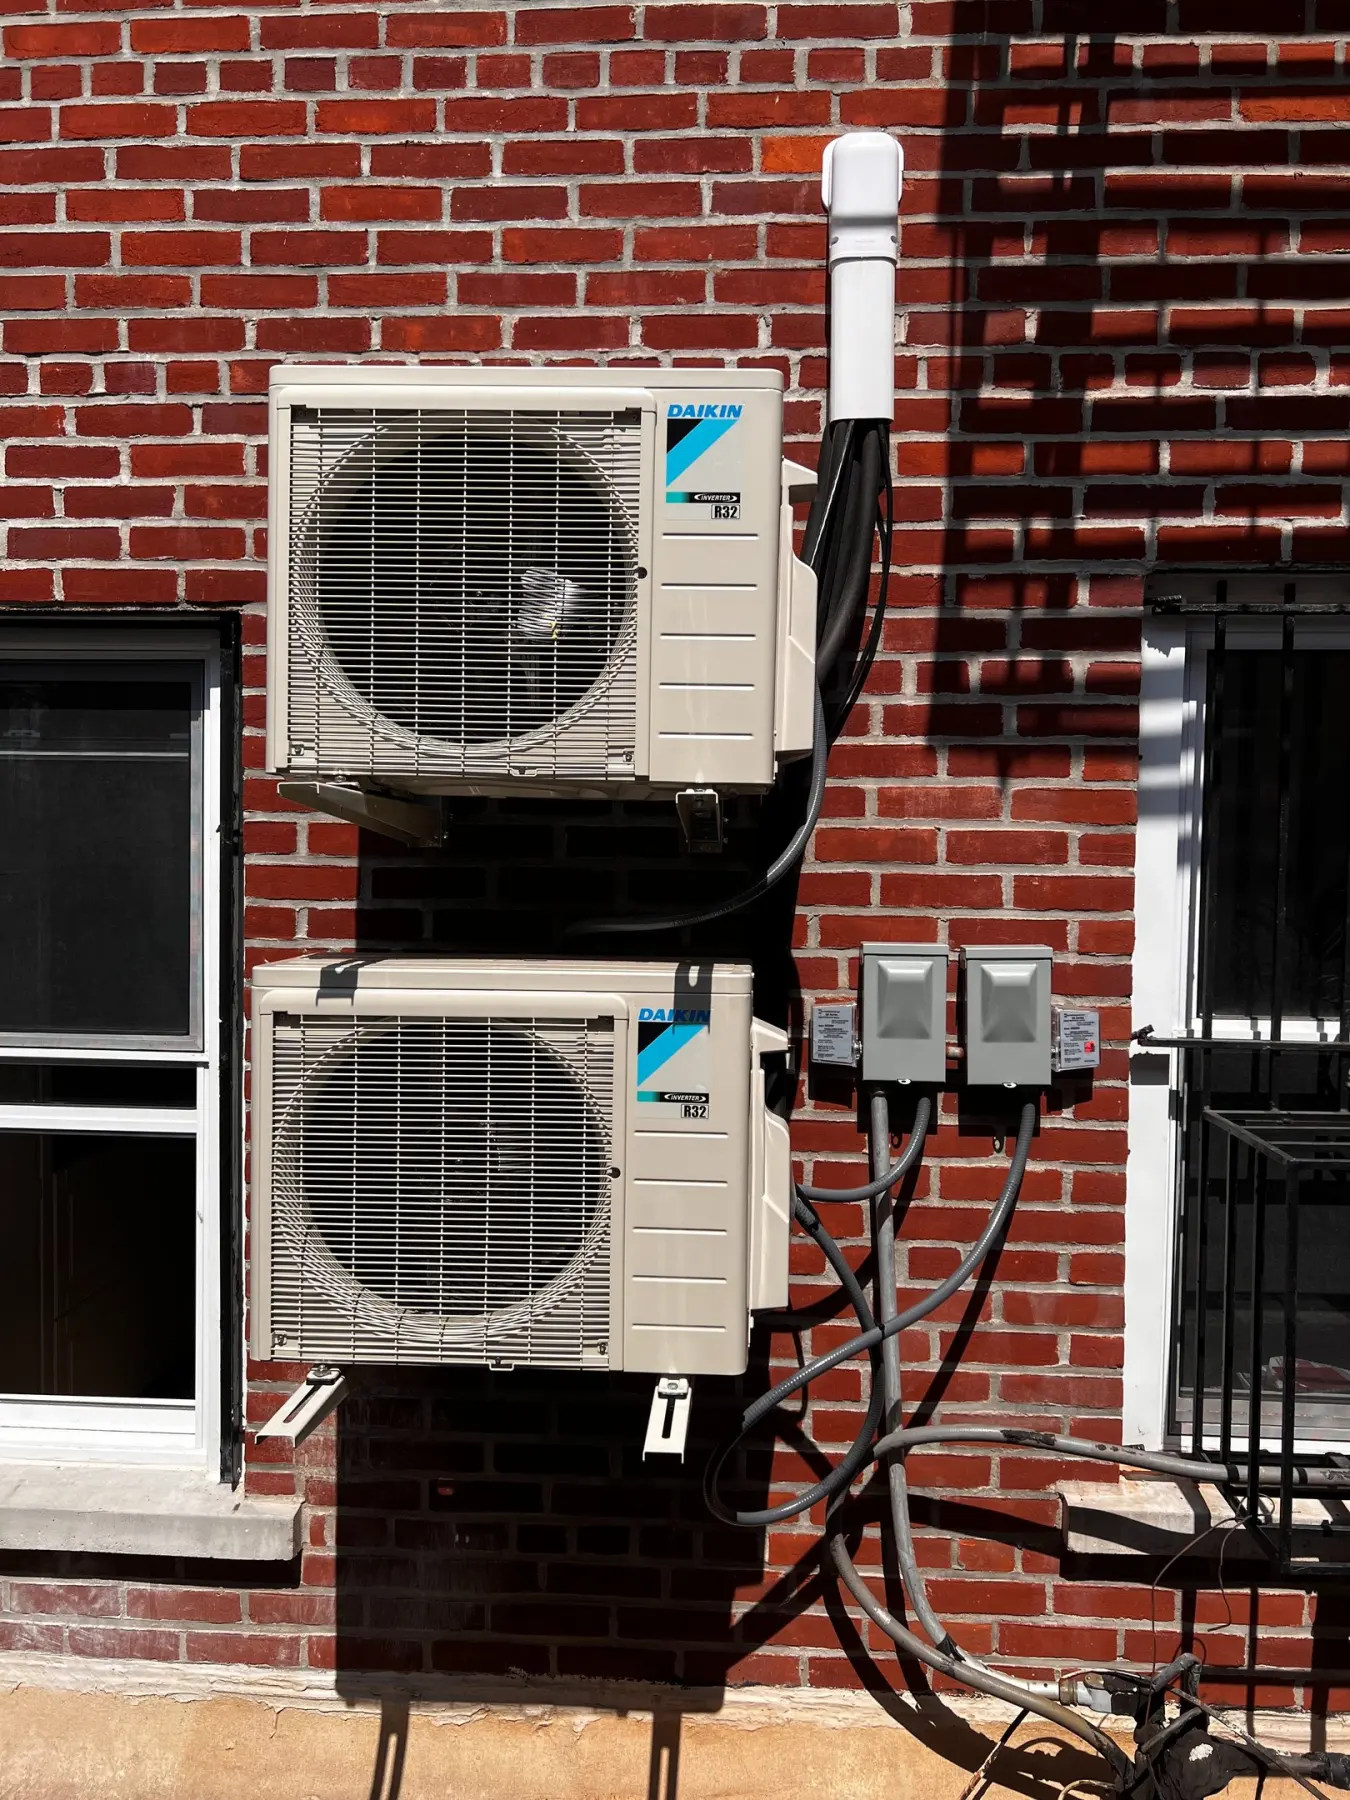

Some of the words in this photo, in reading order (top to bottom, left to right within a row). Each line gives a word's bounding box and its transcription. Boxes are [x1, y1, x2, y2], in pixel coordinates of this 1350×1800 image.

[667, 404, 743, 418] DAIKIN
[714, 505, 738, 519] R32
[638, 1007, 711, 1022] DAIKIN
[683, 1105, 707, 1119] R32
